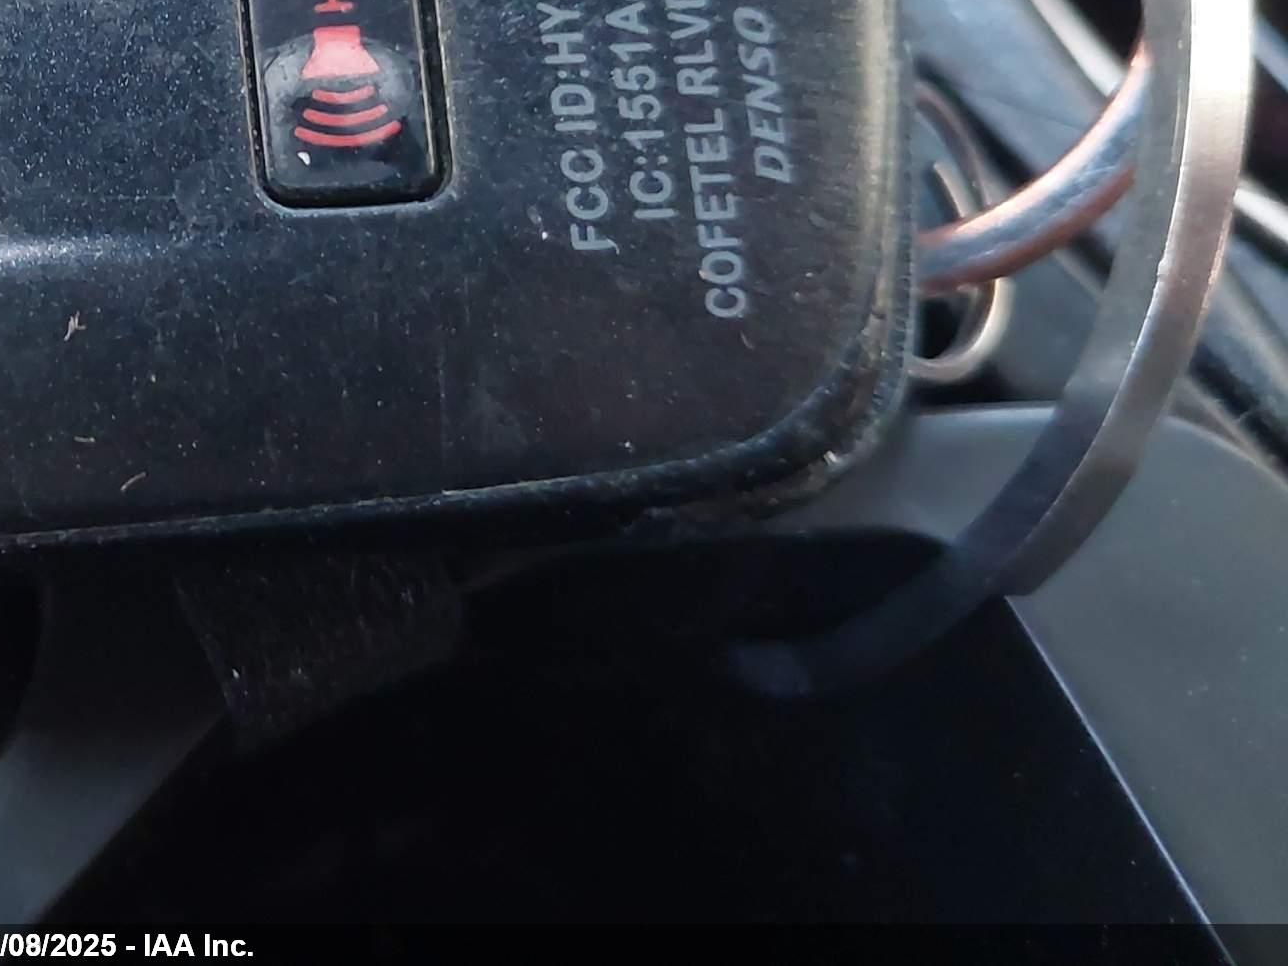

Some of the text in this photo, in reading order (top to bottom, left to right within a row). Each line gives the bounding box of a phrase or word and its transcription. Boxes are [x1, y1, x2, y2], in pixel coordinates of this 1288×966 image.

[732, 8, 794, 184] DENSO
[561, 147, 612, 252] FCC
[683, 109, 748, 318] COFETEL
